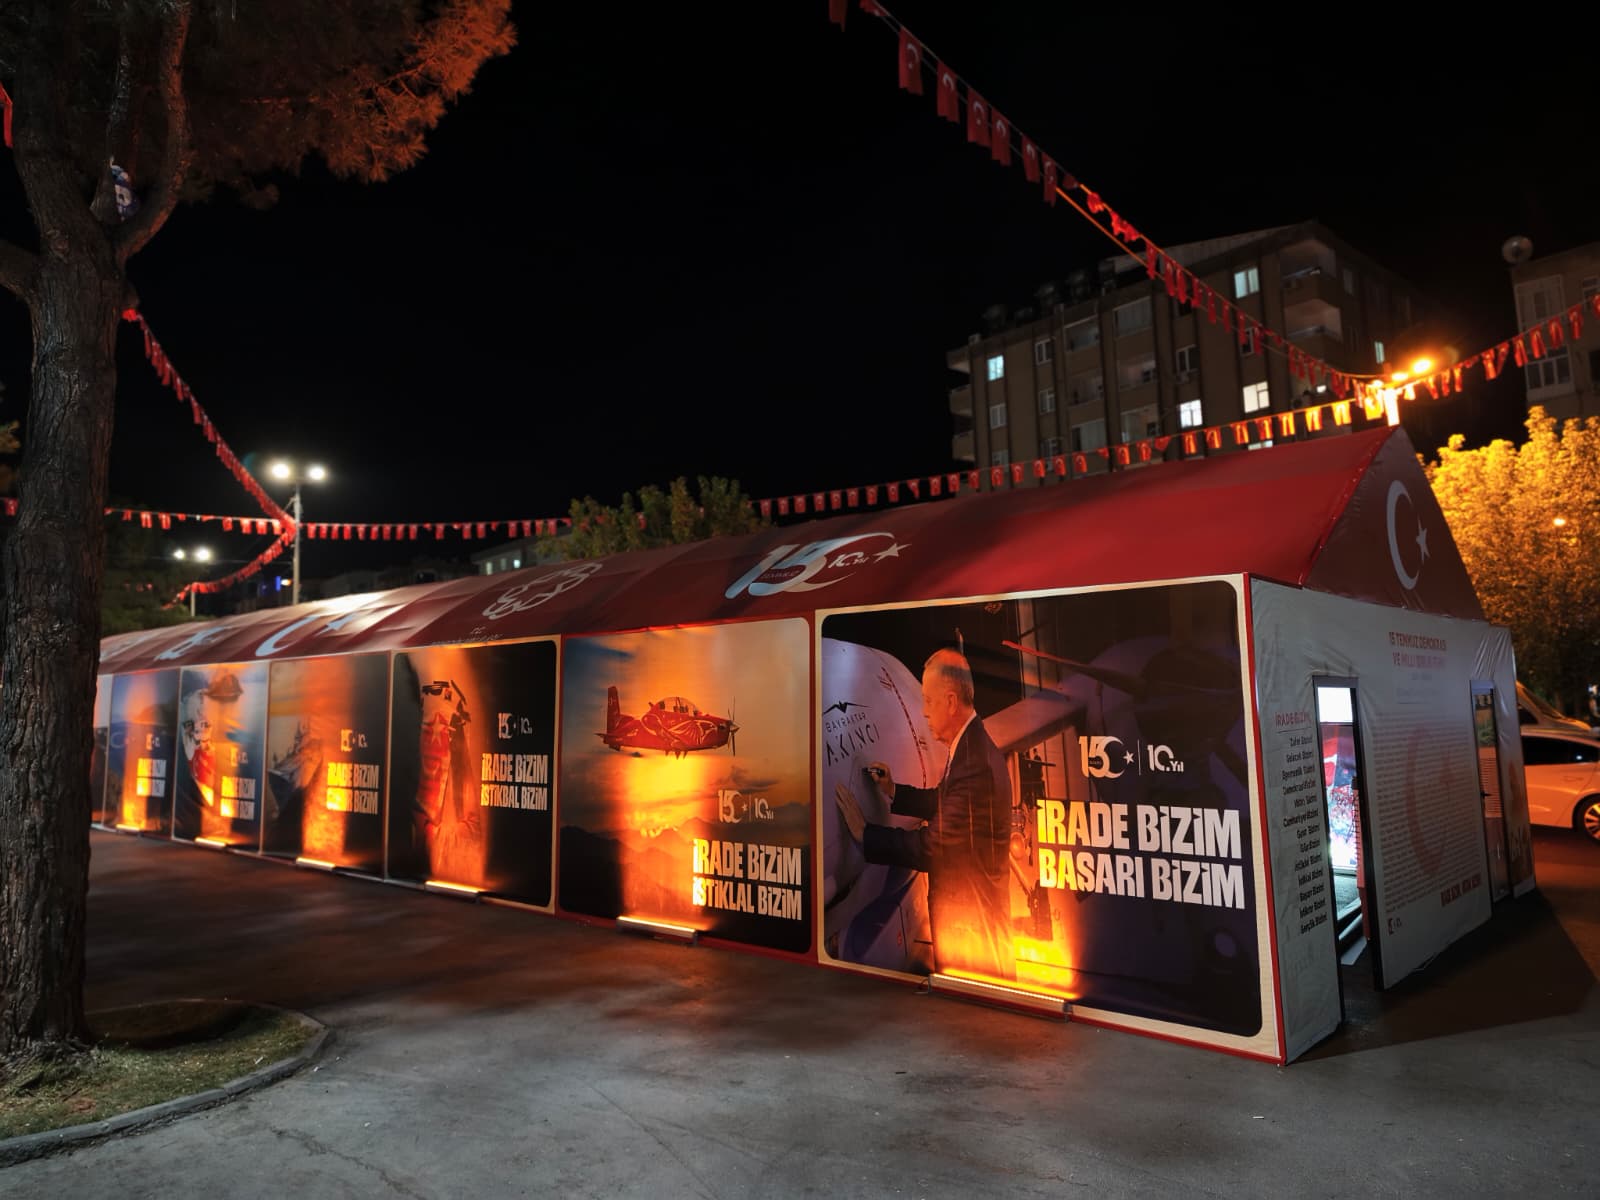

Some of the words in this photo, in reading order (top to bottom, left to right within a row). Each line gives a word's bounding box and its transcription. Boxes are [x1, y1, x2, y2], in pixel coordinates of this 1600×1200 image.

[825, 712, 866, 733] BAYRAKTAR
[826, 723, 880, 767] AKINCI
[482, 753, 513, 782] İRADE
[515, 754, 548, 784] BİZİM
[481, 784, 519, 808] İSTİKBAL
[521, 787, 548, 810] BİZİM
[1037, 799, 1130, 850] İRADE
[1136, 804, 1242, 859] BİZİM
[692, 838, 743, 879] İRADE
[747, 844, 802, 886] BİZİM
[1151, 857, 1246, 910] BİZİM
[692, 876, 755, 914] İSTİKLAL
[758, 885, 802, 920] BİZİM
